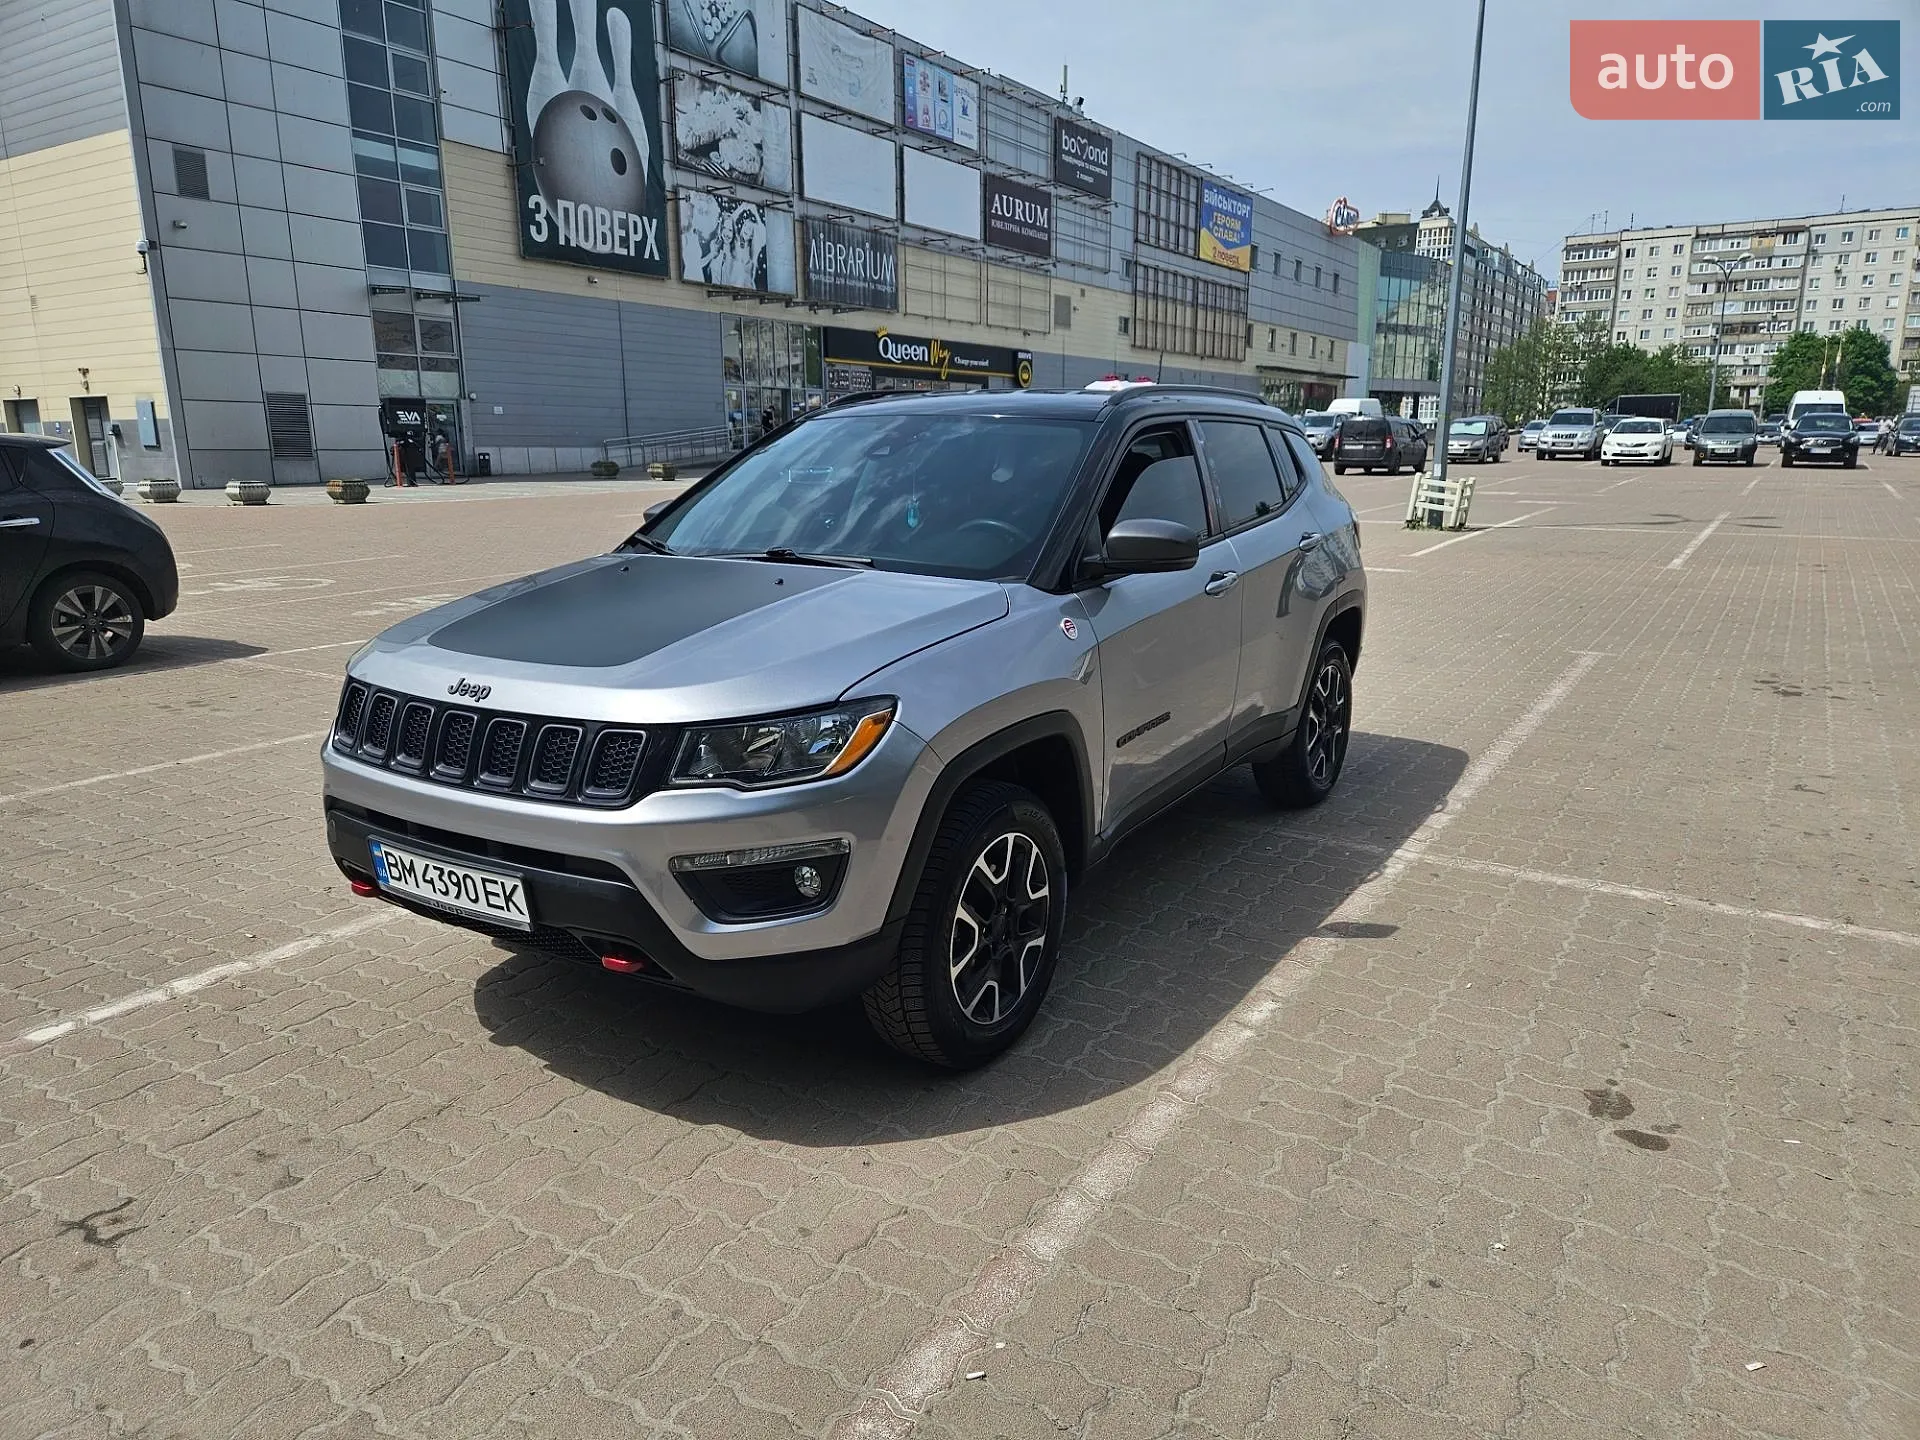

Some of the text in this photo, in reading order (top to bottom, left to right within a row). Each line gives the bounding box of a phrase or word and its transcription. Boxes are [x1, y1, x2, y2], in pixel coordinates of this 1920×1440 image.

[991, 192, 1049, 229] AURUM
[1203, 188, 1251, 218] ВІЙСЬКТОРГ
[528, 194, 661, 261] 3 ПОВЕРХ
[878, 336, 929, 363] Queen
[396, 411, 421, 421] EVA
[447, 678, 492, 703] Jeep
